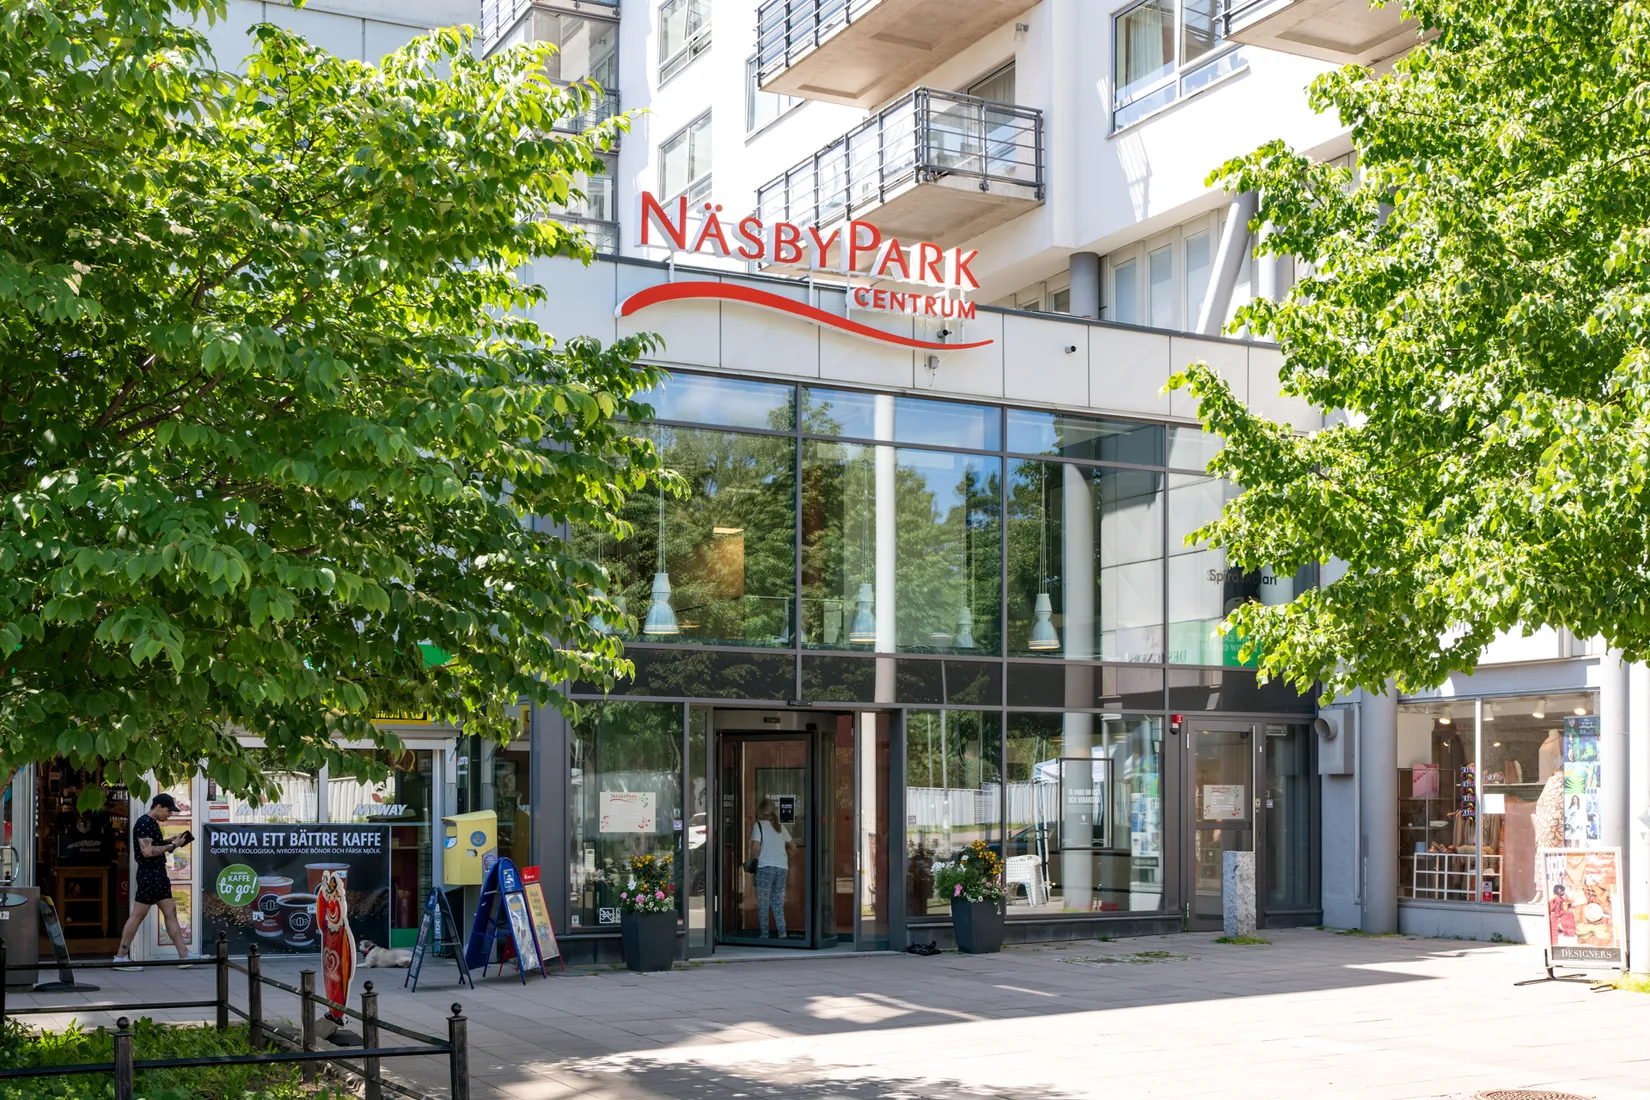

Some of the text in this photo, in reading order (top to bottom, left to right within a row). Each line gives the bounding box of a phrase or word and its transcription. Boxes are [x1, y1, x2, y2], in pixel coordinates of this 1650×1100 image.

[852, 286, 977, 321] CENTRUM
[352, 804, 409, 816] MYWAY
[210, 829, 382, 847] PROVA ETT BÄTTRE KAFFE
[228, 874, 251, 882] KAFFE
[218, 876, 257, 903] to go!
[1560, 949, 1612, 959] DESIGNERS
